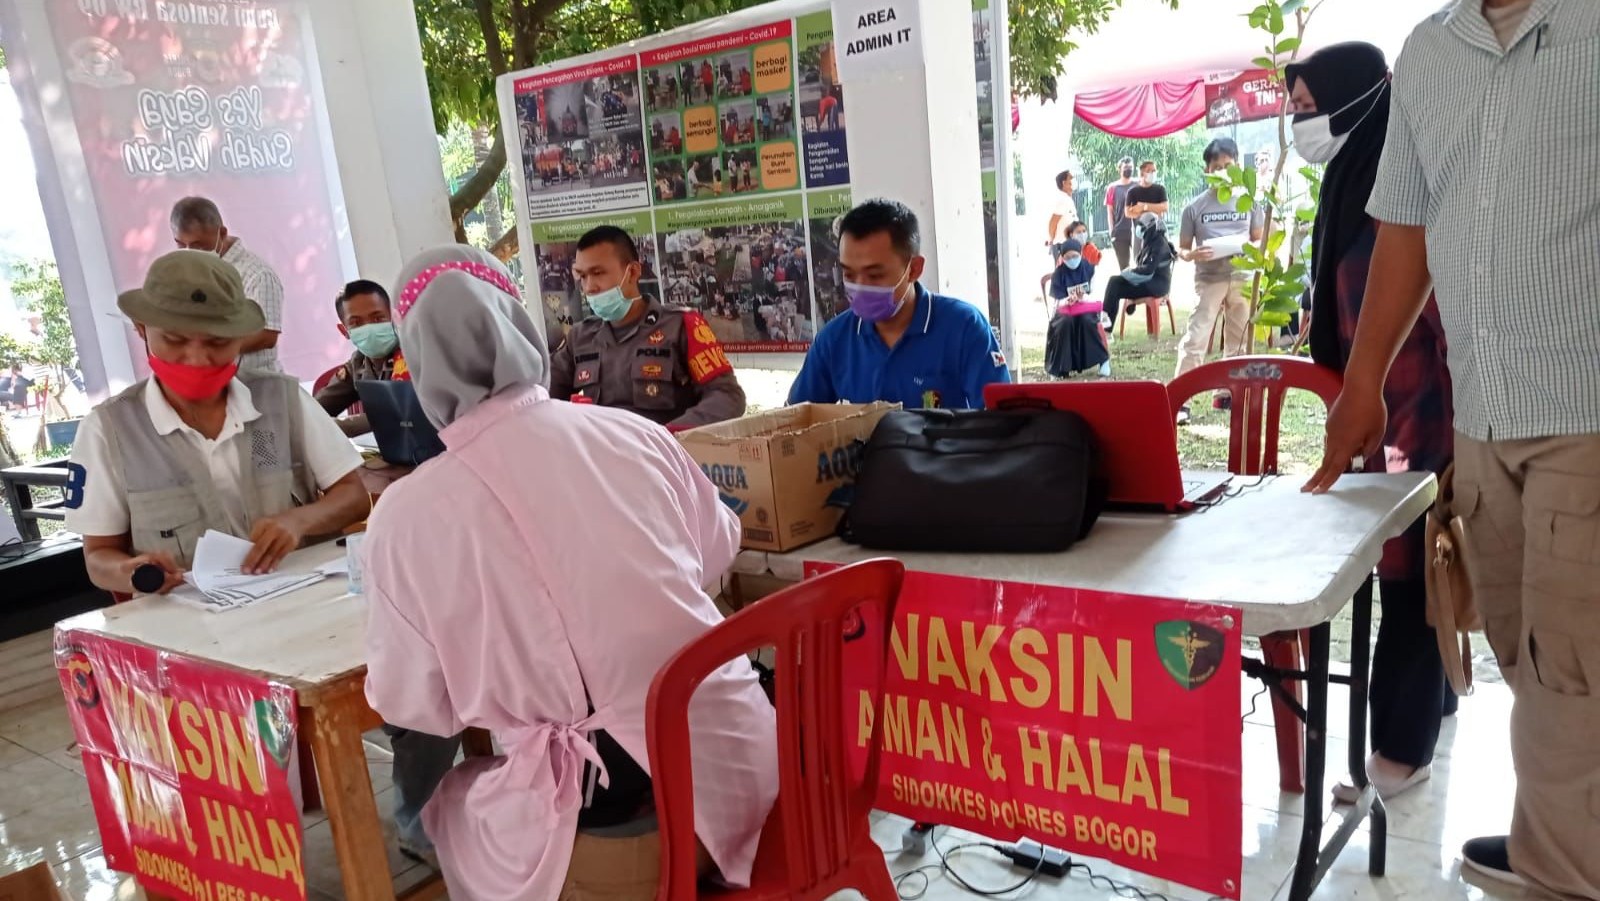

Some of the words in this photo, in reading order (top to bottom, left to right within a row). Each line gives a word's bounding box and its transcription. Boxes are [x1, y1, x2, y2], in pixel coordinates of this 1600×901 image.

[857, 7, 896, 29] AREA
[846, 32, 893, 56] ADMIN
[897, 27, 911, 44] IT
[756, 55, 787, 69] berbagi
[756, 66, 787, 78] masker
[1255, 88, 1276, 106] TNI
[1203, 212, 1247, 223] greenlight
[701, 463, 748, 493] AQUA
[816, 443, 864, 484] AQU
[890, 612, 1132, 721] VAKSIN
[103, 677, 266, 797] VAKSIN
[857, 689, 970, 769] AMAN
[981, 718, 1007, 782] &
[1017, 725, 1189, 817] HALAL
[106, 757, 178, 843] MAN
[892, 773, 986, 822] SIDOKKES
[989, 798, 1067, 838] POLRES
[1073, 814, 1158, 862] BOGOR
